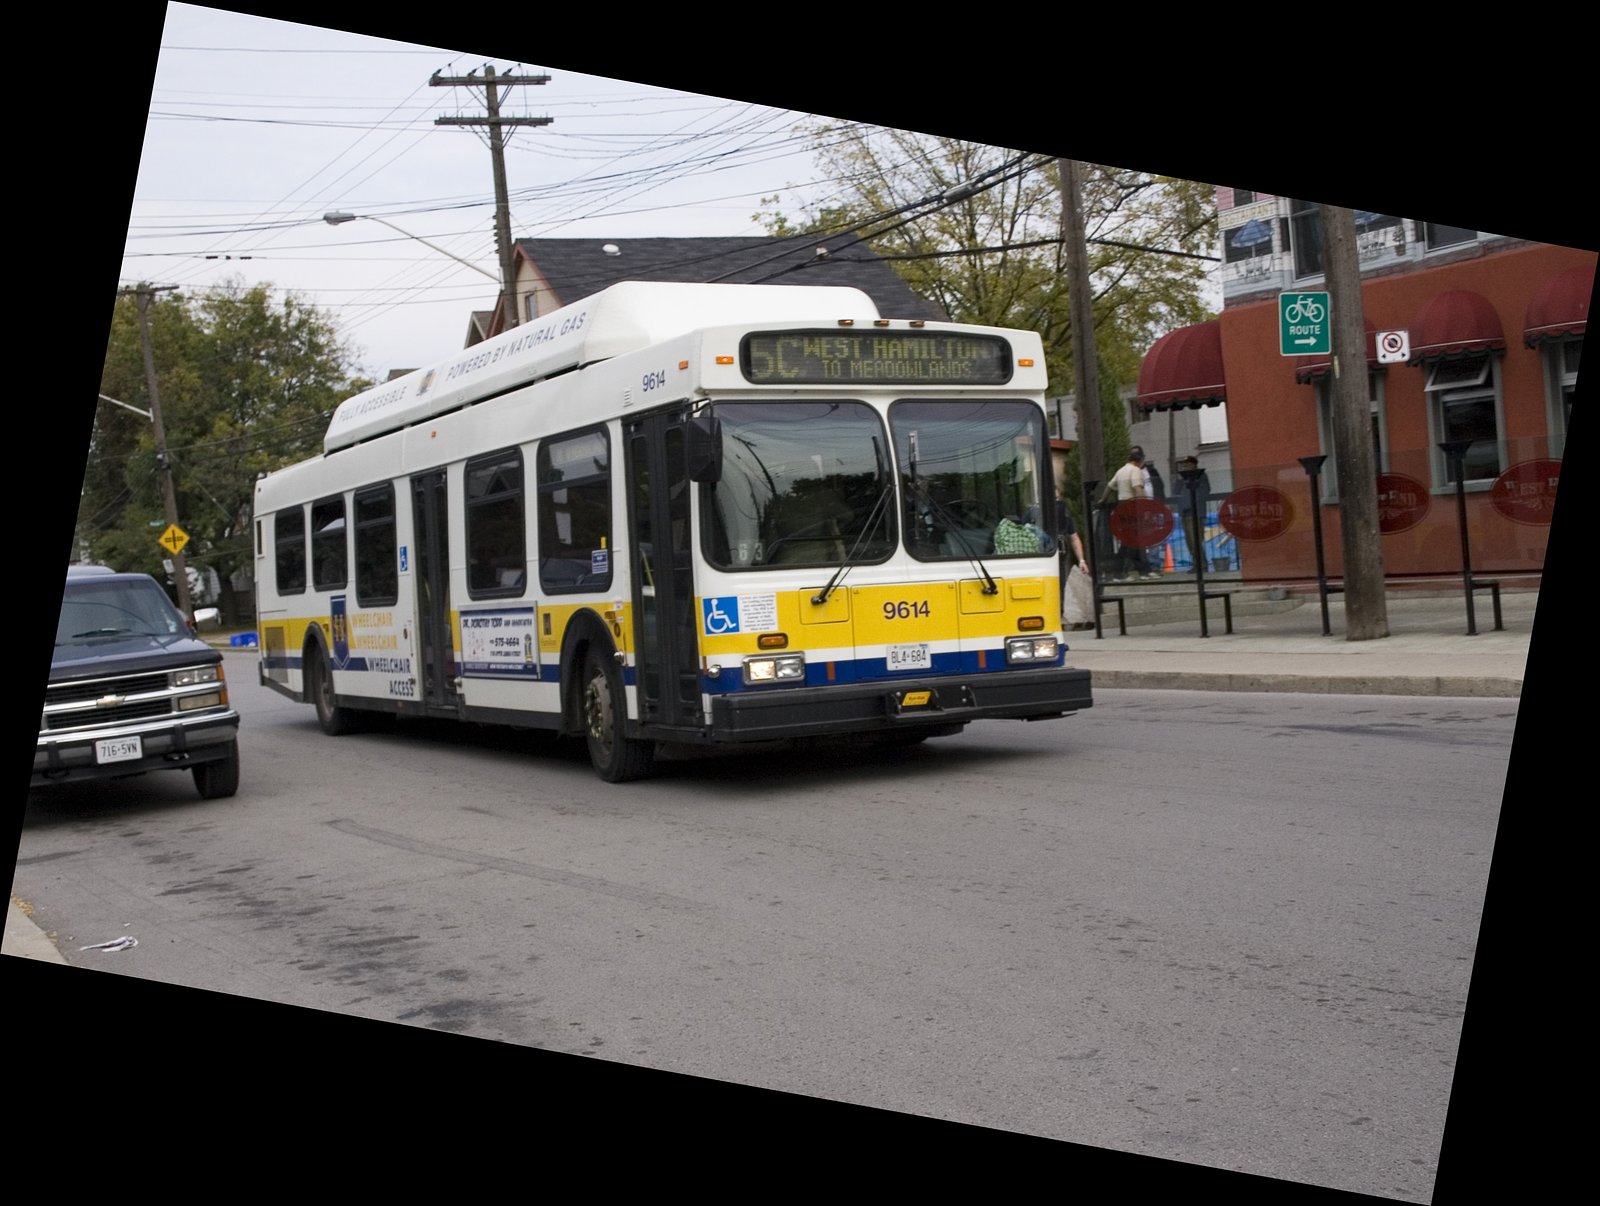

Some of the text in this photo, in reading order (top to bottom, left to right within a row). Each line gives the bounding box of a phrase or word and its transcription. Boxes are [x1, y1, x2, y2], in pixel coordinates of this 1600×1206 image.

[1289, 325, 1321, 335] ROUTE
[446, 312, 586, 381] POWERED BY NATURAL GAS
[803, 337, 860, 359] WEST
[821, 360, 972, 379] TO MEADOWLANDS
[642, 369, 666, 392] 9614
[360, 386, 407, 413] ACCESSIBLE
[1389, 490, 1417, 506] END
[883, 600, 930, 620] 9614
[352, 612, 393, 628] WHEELCHAIR
[354, 634, 397, 650] WHEELCHAIR
[368, 657, 411, 674] WHEELCHAIR
[389, 680, 414, 697] ACCESS
